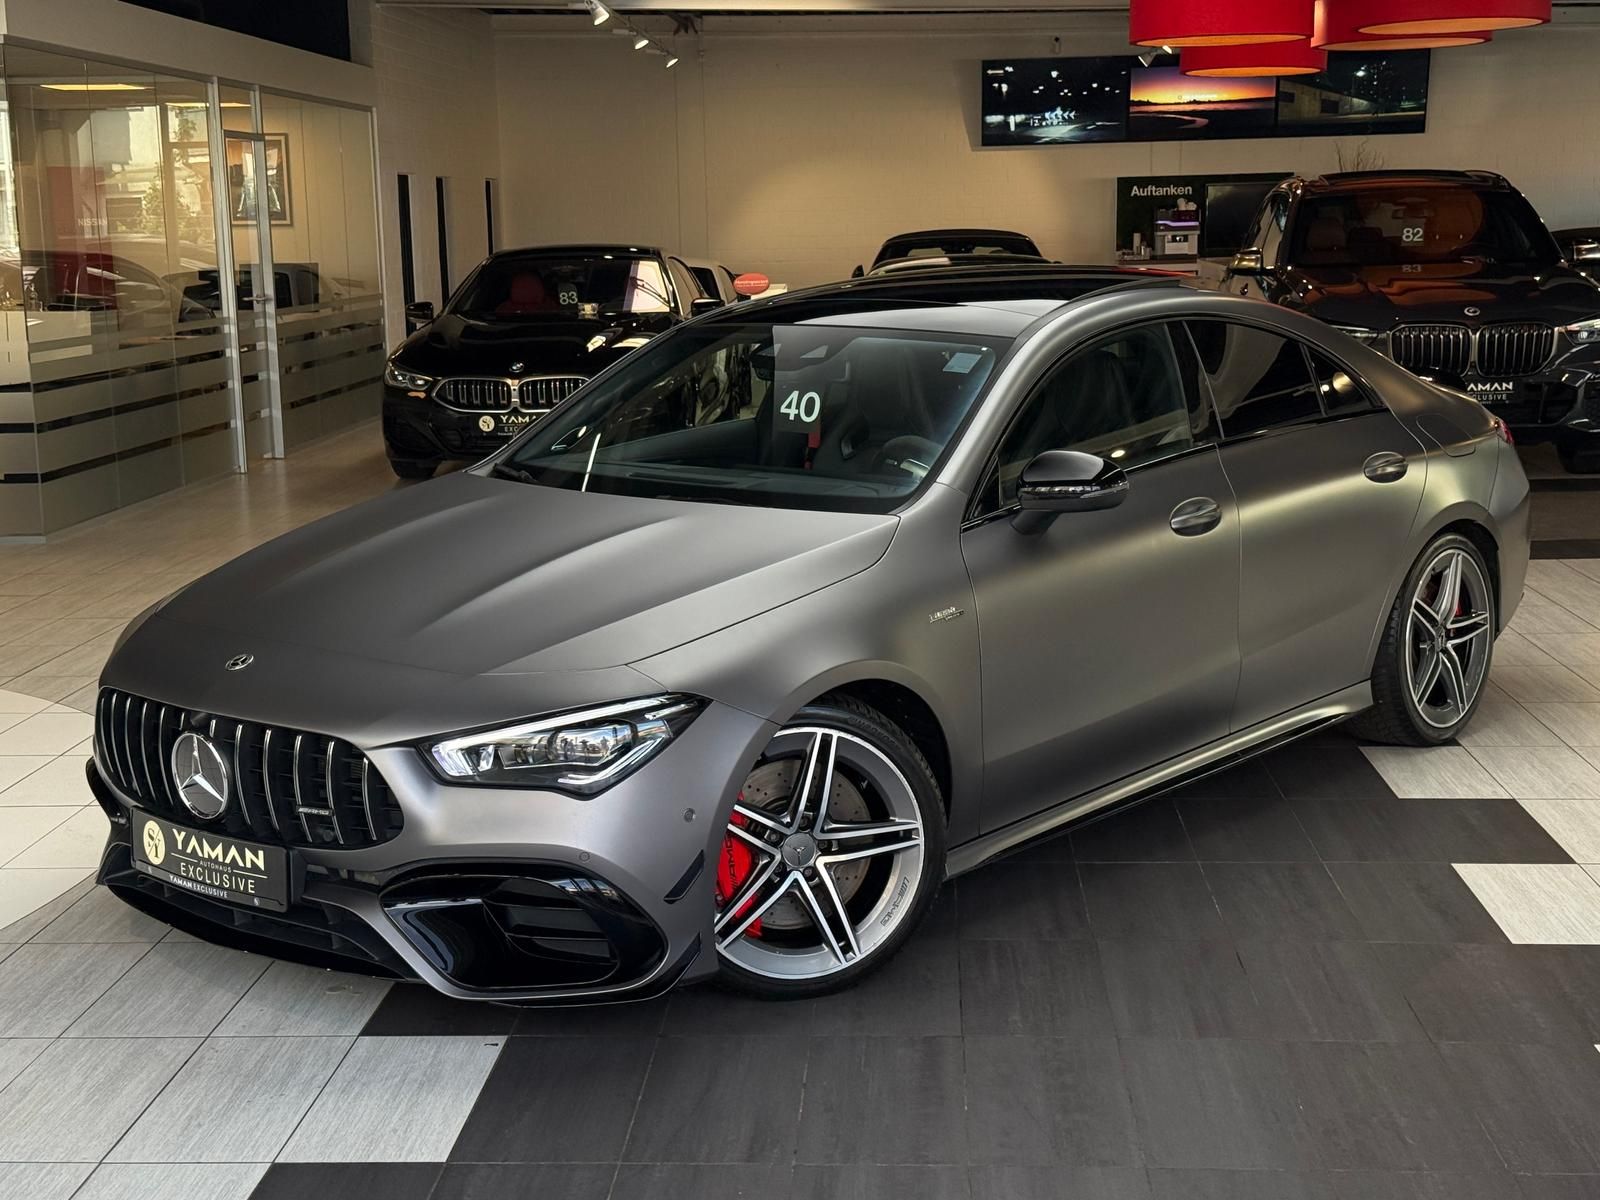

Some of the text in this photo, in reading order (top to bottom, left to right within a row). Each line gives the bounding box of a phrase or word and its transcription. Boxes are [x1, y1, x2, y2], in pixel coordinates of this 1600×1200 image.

[1130, 184, 1193, 197] Auftanken
[1402, 227, 1424, 242] 82
[559, 291, 578, 305] 83
[1465, 381, 1513, 391] AMAN
[1471, 393, 1507, 401] CLUSIVE
[780, 390, 821, 423] 40
[171, 827, 265, 871] YAMAN
[200, 860, 232, 873] AUTOHAUS
[180, 862, 256, 894] EXCLUSIVE
